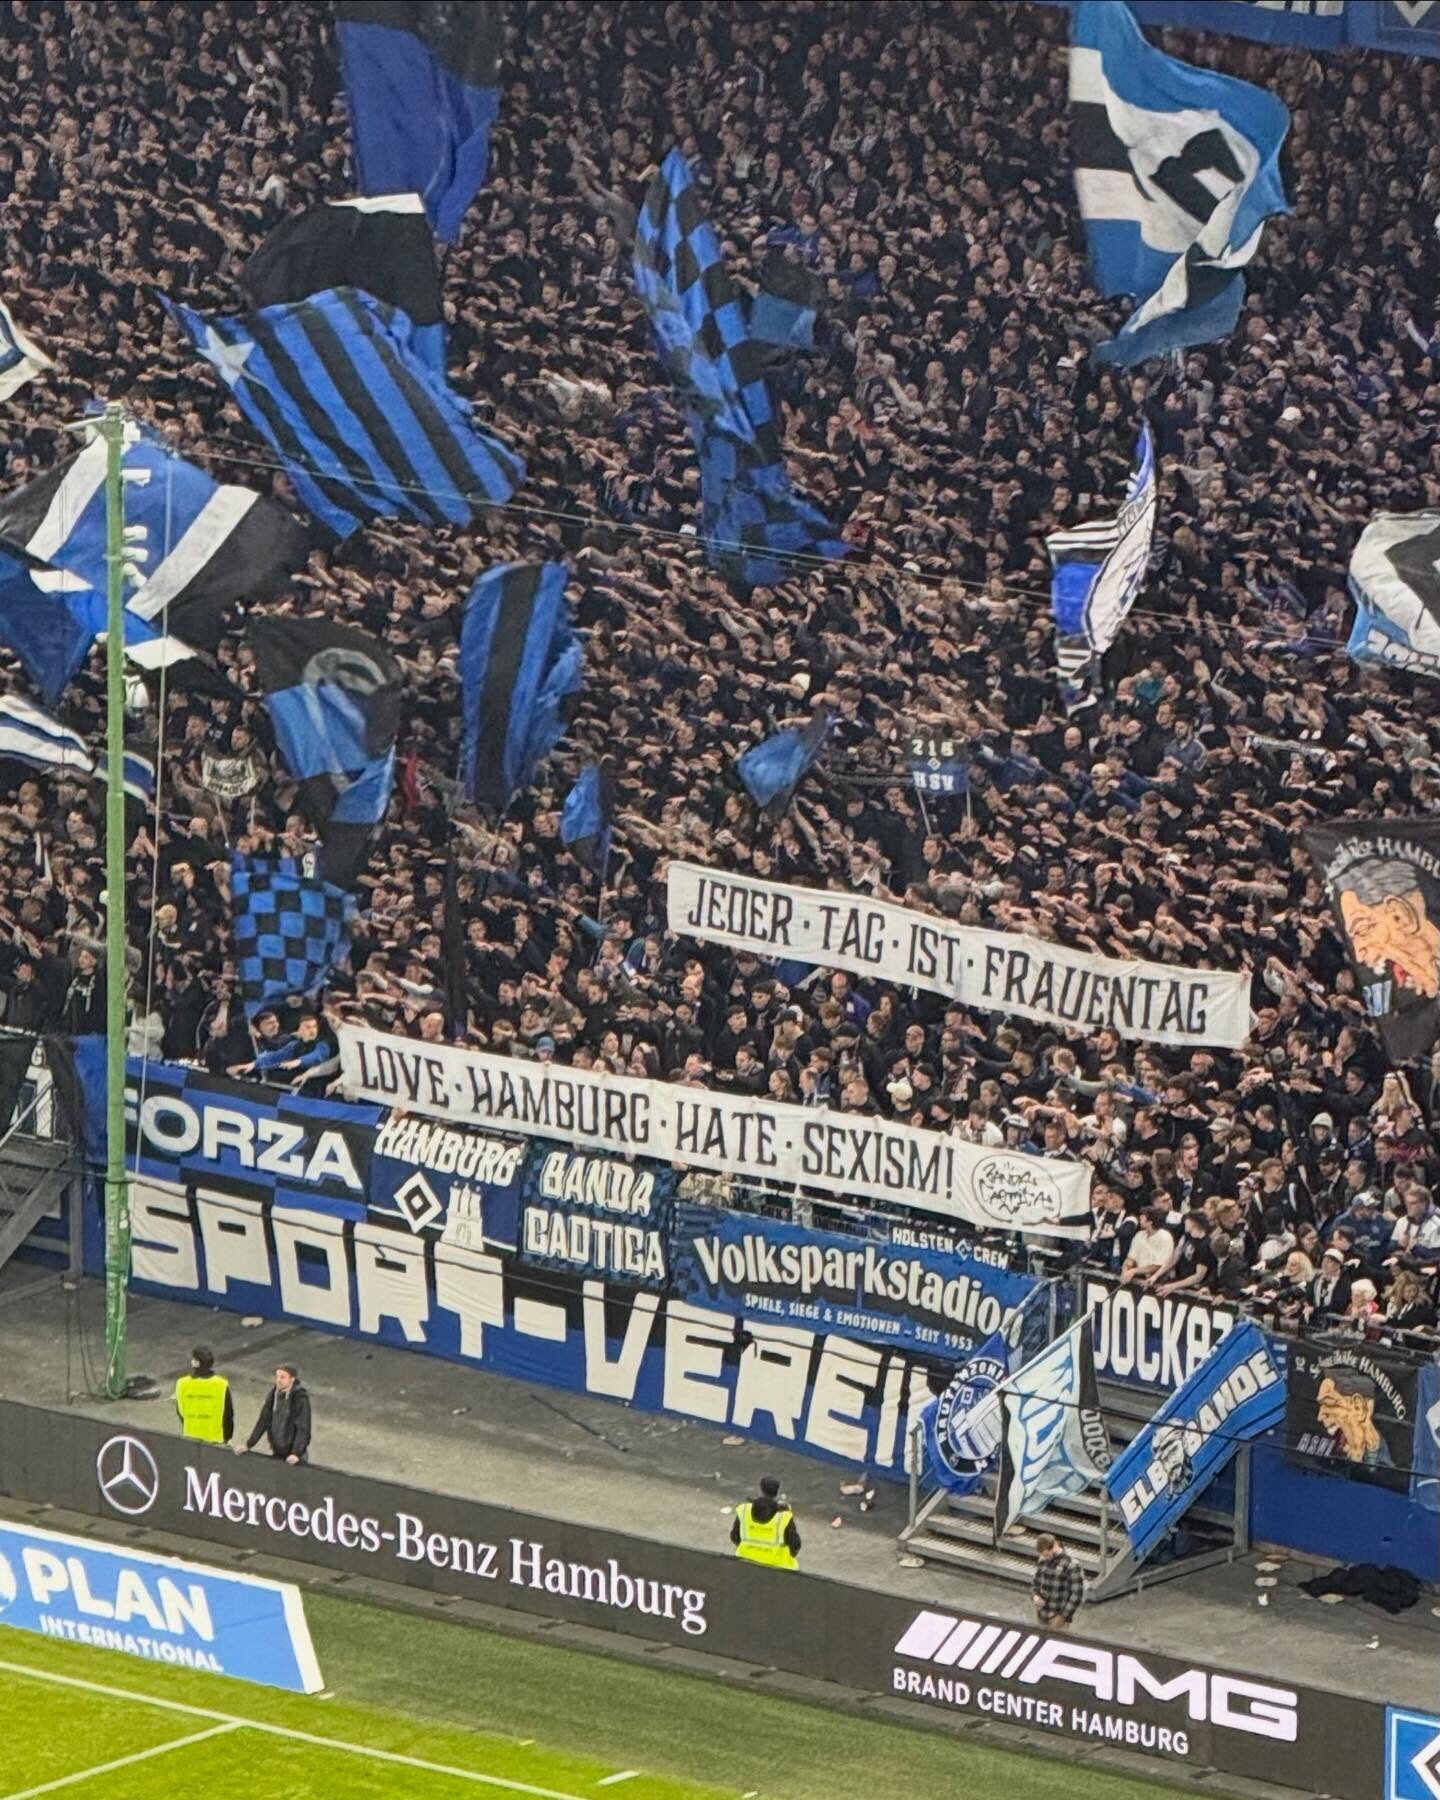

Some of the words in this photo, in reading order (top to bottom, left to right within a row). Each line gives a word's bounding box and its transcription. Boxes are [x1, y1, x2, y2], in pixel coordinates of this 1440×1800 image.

[687, 878, 793, 947] JEDER
[818, 904, 886, 964] TAG
[906, 923, 960, 986] IST
[981, 944, 1208, 1034] FRAUENTAG
[356, 1040, 449, 1107] LOVE
[466, 1065, 650, 1144] HAMBURG
[674, 1100, 778, 1167] HATE
[801, 1121, 956, 1200] SEXISM!
[374, 1115, 523, 1187] HAMBURG
[539, 1151, 654, 1218] BANDA
[523, 1206, 665, 1280] CAOTICA
[892, 1226, 955, 1255] HOLSTEN
[973, 1245, 1009, 1270] CREW
[744, 1292, 785, 1317] SPIELE,
[789, 1301, 820, 1322] SIEGE
[822, 1306, 833, 1322] &
[836, 1311, 901, 1335] EMOTIONEN
[914, 1325, 940, 1345] SEIT
[943, 1331, 974, 1352] 1953
[182, 1465, 499, 1580] Mercedes-Benz
[508, 1537, 708, 1636] Hamburg
[21, 1546, 215, 1642] PLAN
[38, 1613, 225, 1673] INTERNATIONAL
[892, 1667, 971, 1706] BRAND
[976, 1687, 1064, 1728] CENTER
[1071, 1707, 1190, 1755] HAMBURG
[1018, 1639, 1298, 1742] AMG
